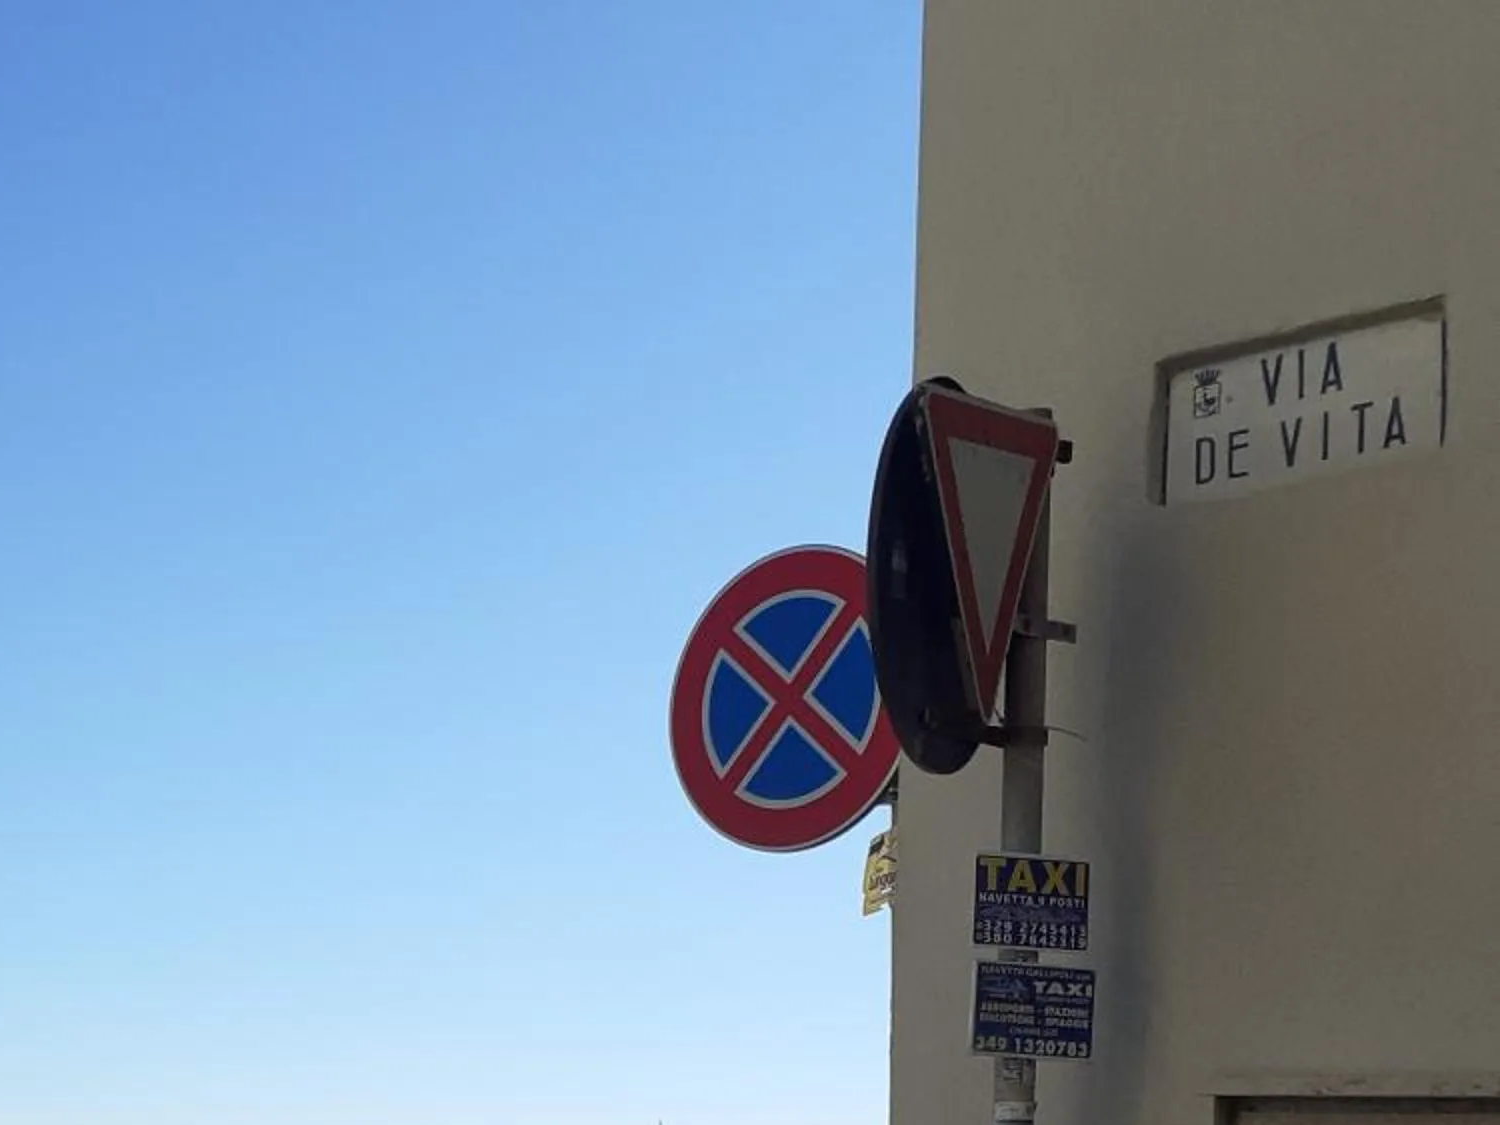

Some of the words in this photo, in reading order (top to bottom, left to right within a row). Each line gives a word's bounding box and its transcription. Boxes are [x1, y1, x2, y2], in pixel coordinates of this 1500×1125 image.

[1260, 341, 1344, 407] VIA
[1195, 429, 1250, 485] DE
[1281, 396, 1407, 468] VITA
[980, 857, 1086, 896] TAXI
[980, 892, 1033, 906] NAVETTA
[1050, 896, 1086, 909] POSTI
[1033, 981, 1094, 998] TAXI
[975, 1036, 1008, 1051] 349
[1014, 1038, 1089, 1057] 1320783
